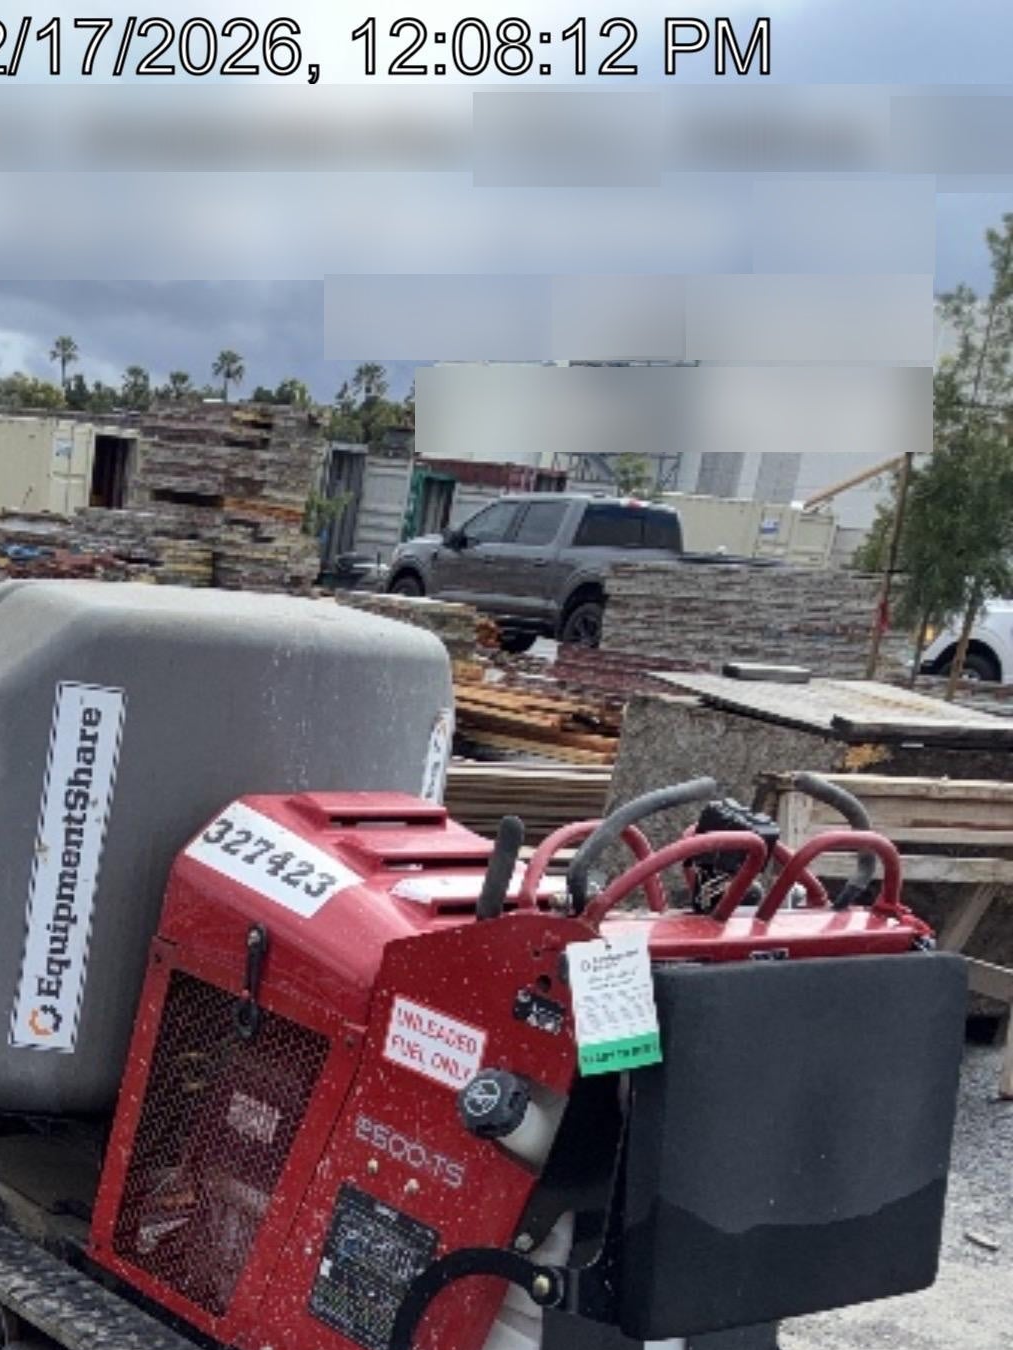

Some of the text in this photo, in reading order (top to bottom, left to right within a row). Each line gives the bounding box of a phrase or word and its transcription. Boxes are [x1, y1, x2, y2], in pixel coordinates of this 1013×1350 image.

[37, 705, 102, 1000] EquipmentShare
[203, 818, 338, 898] 327423
[391, 1033, 472, 1081] FUEL ONLY
[397, 1006, 478, 1055] UNLEADED
